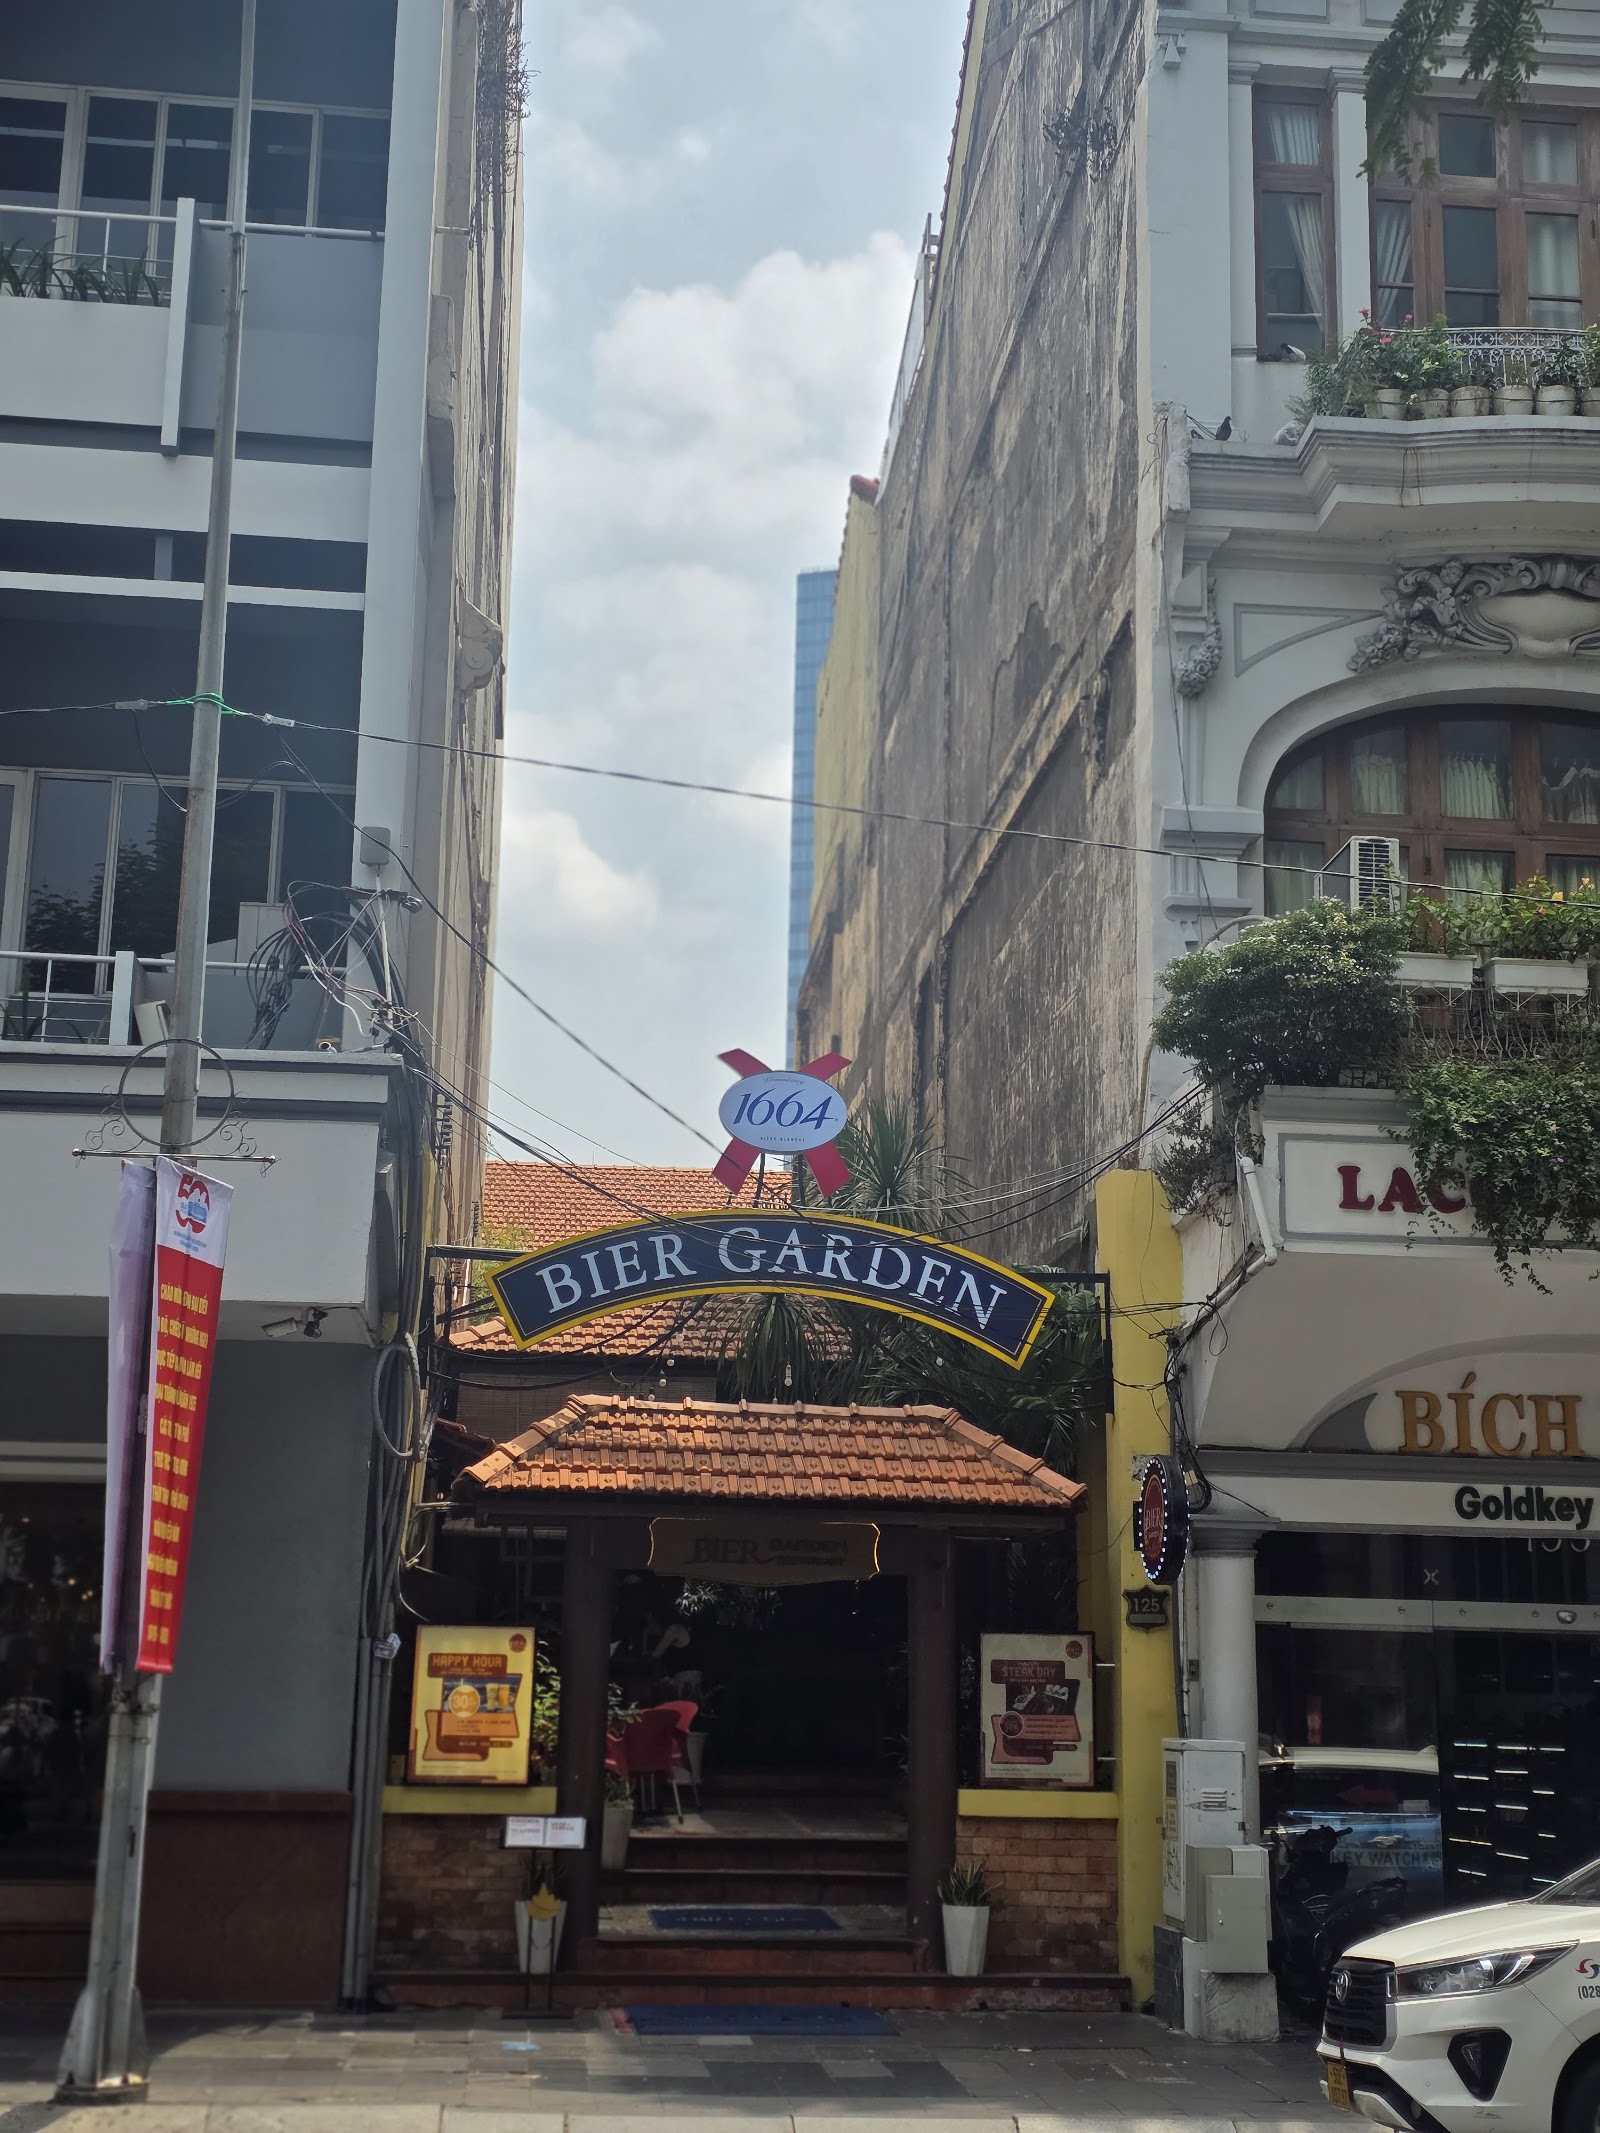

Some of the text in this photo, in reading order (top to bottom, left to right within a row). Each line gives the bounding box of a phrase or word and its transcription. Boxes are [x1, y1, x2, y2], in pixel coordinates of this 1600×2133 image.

[732, 1087, 835, 1130] 1664
[1337, 1164, 1480, 1214] LAC
[535, 1227, 1008, 1330] BIER GARDEN
[1394, 1371, 1585, 1458] BÍCH
[1454, 1485, 1594, 1530] Goldkey
[1133, 1597, 1161, 1613] 125
[432, 1655, 502, 1668] HAPPY HOUR
[1036, 1666, 1057, 1678] DAY
[1368, 1851, 1420, 1867] WATCH
